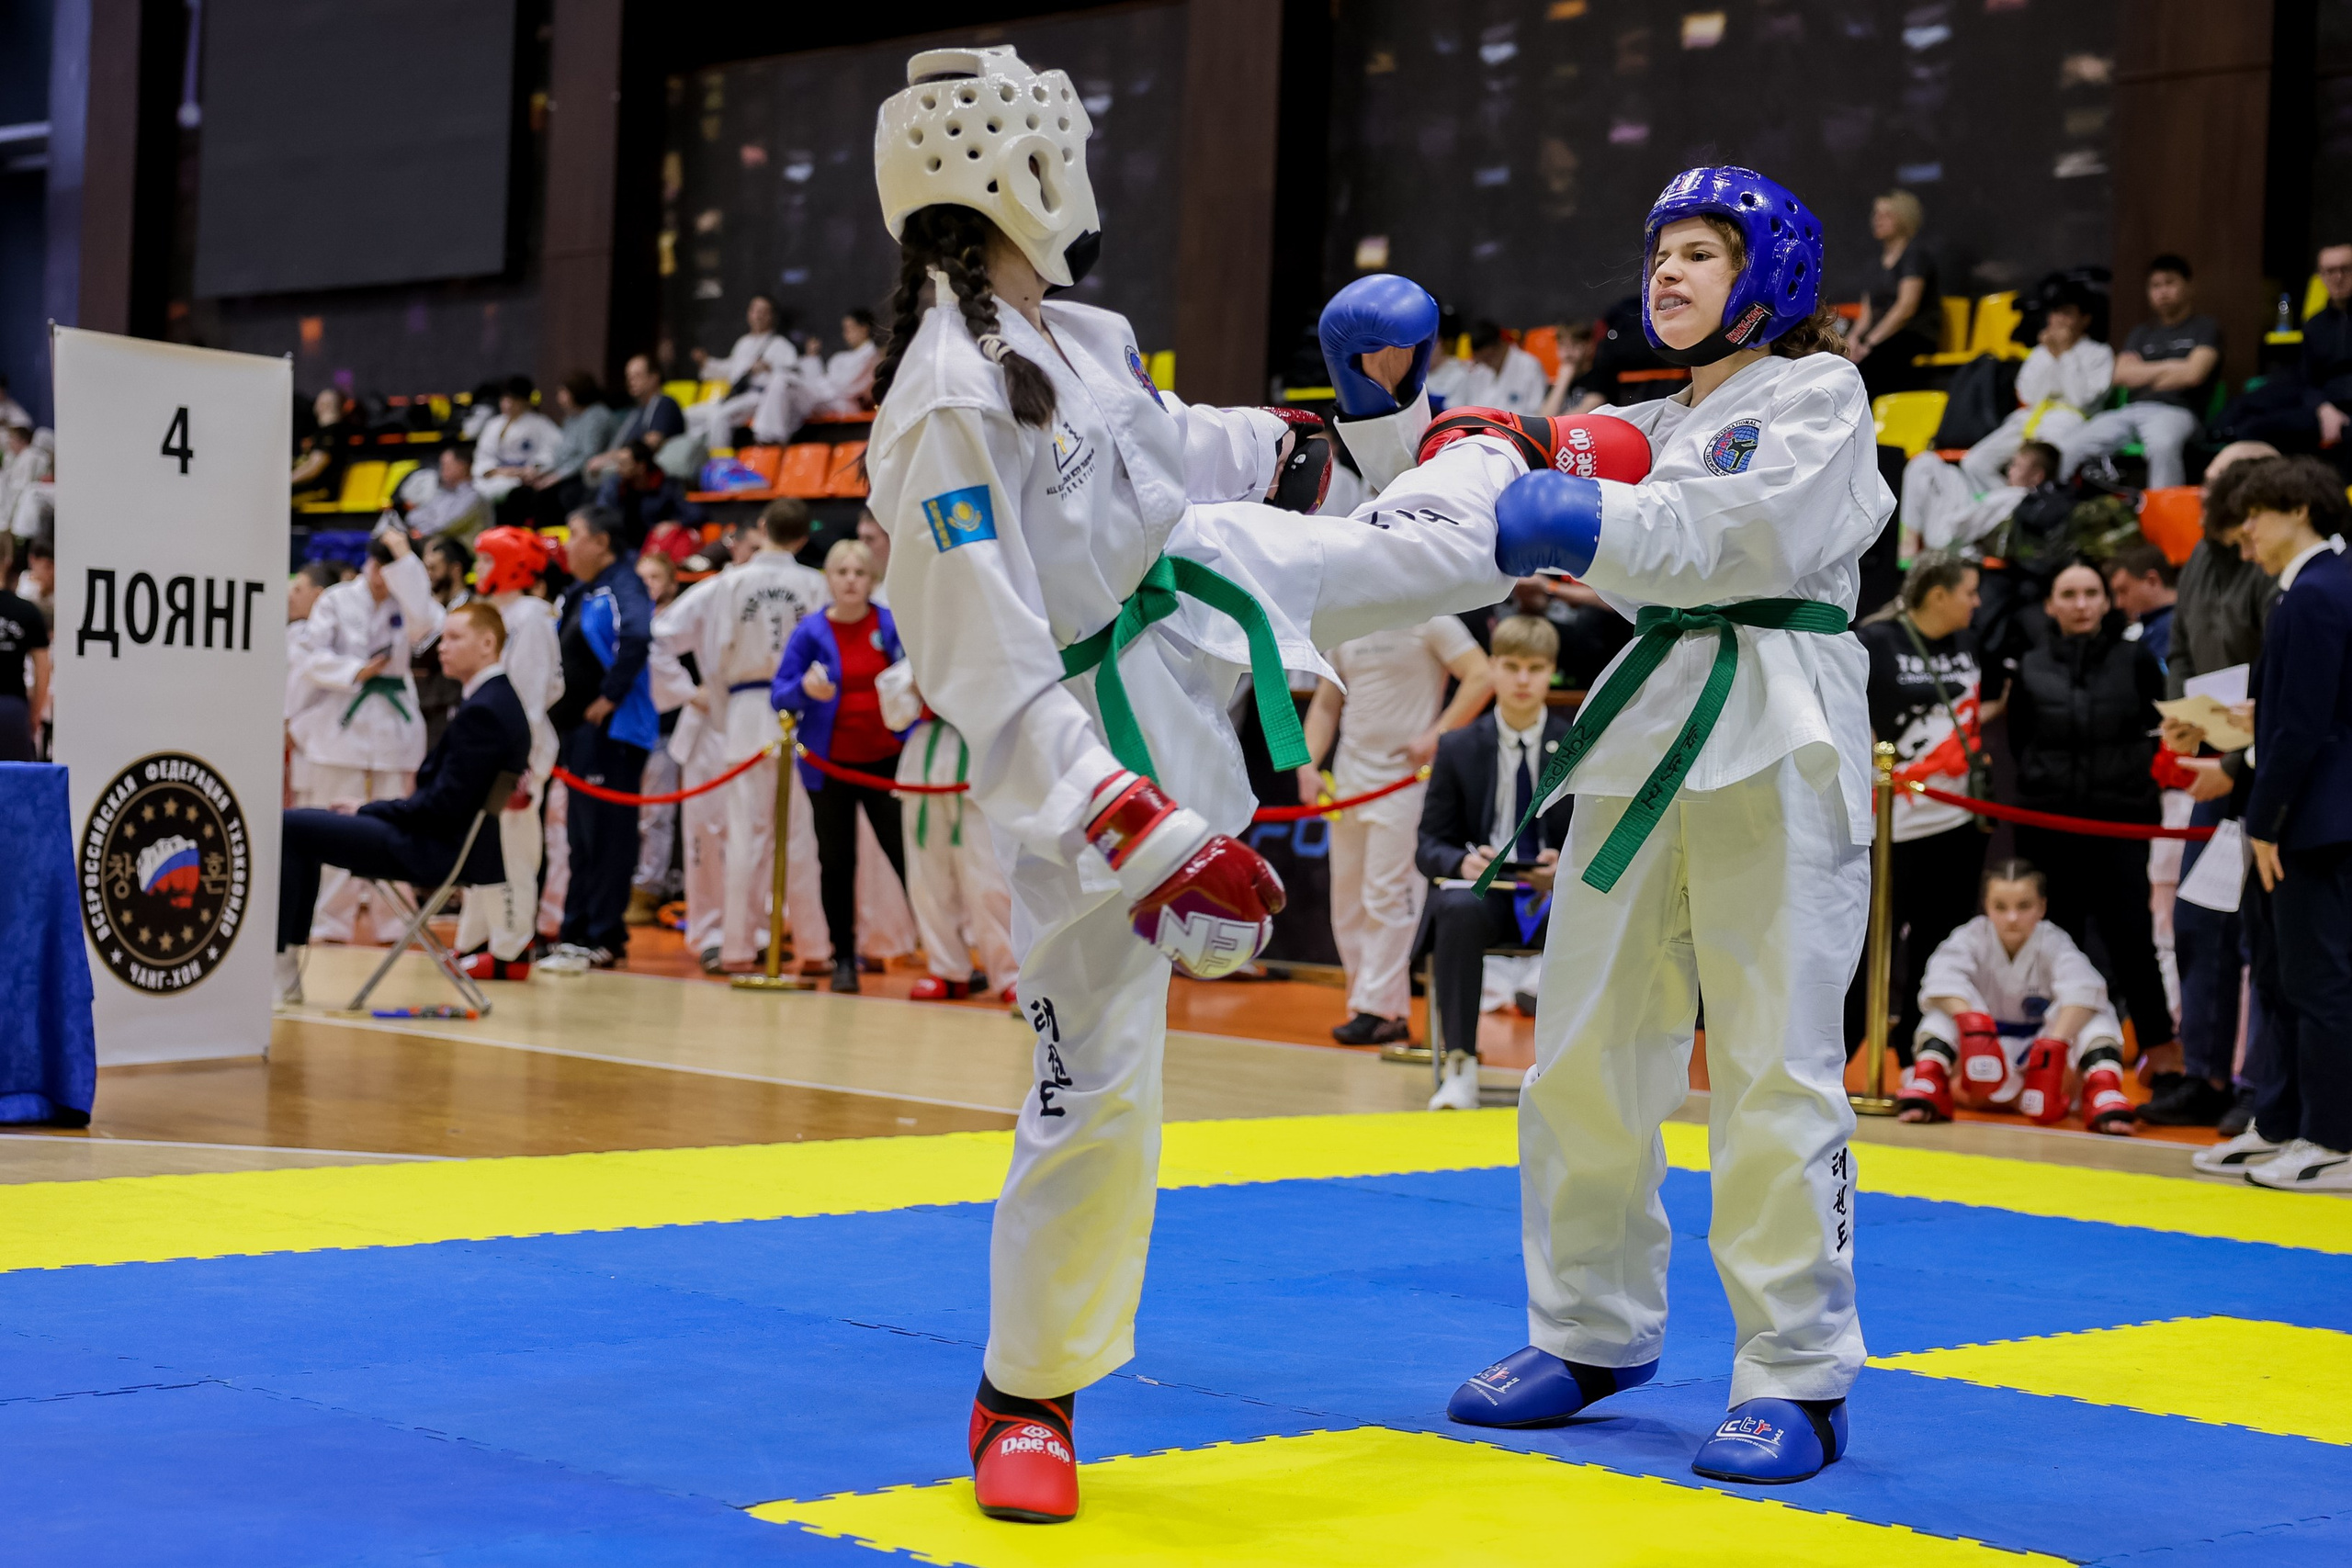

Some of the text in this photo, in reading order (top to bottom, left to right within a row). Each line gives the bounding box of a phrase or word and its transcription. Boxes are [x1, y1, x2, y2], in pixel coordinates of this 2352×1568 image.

[162, 407, 194, 474] 4
[1713, 419, 1757, 442] INTERNATIONAL
[77, 568, 266, 660] ДОЯНГ
[84, 759, 247, 942] ВСЕРОССИЙСКАЯ ФЕДЕРАЦИЯ ТХЭКВОНДО
[130, 959, 202, 990] ЧАНГ-ХОН
[1001, 1437, 1045, 1454] Dae
[1046, 1439, 1071, 1463] do
